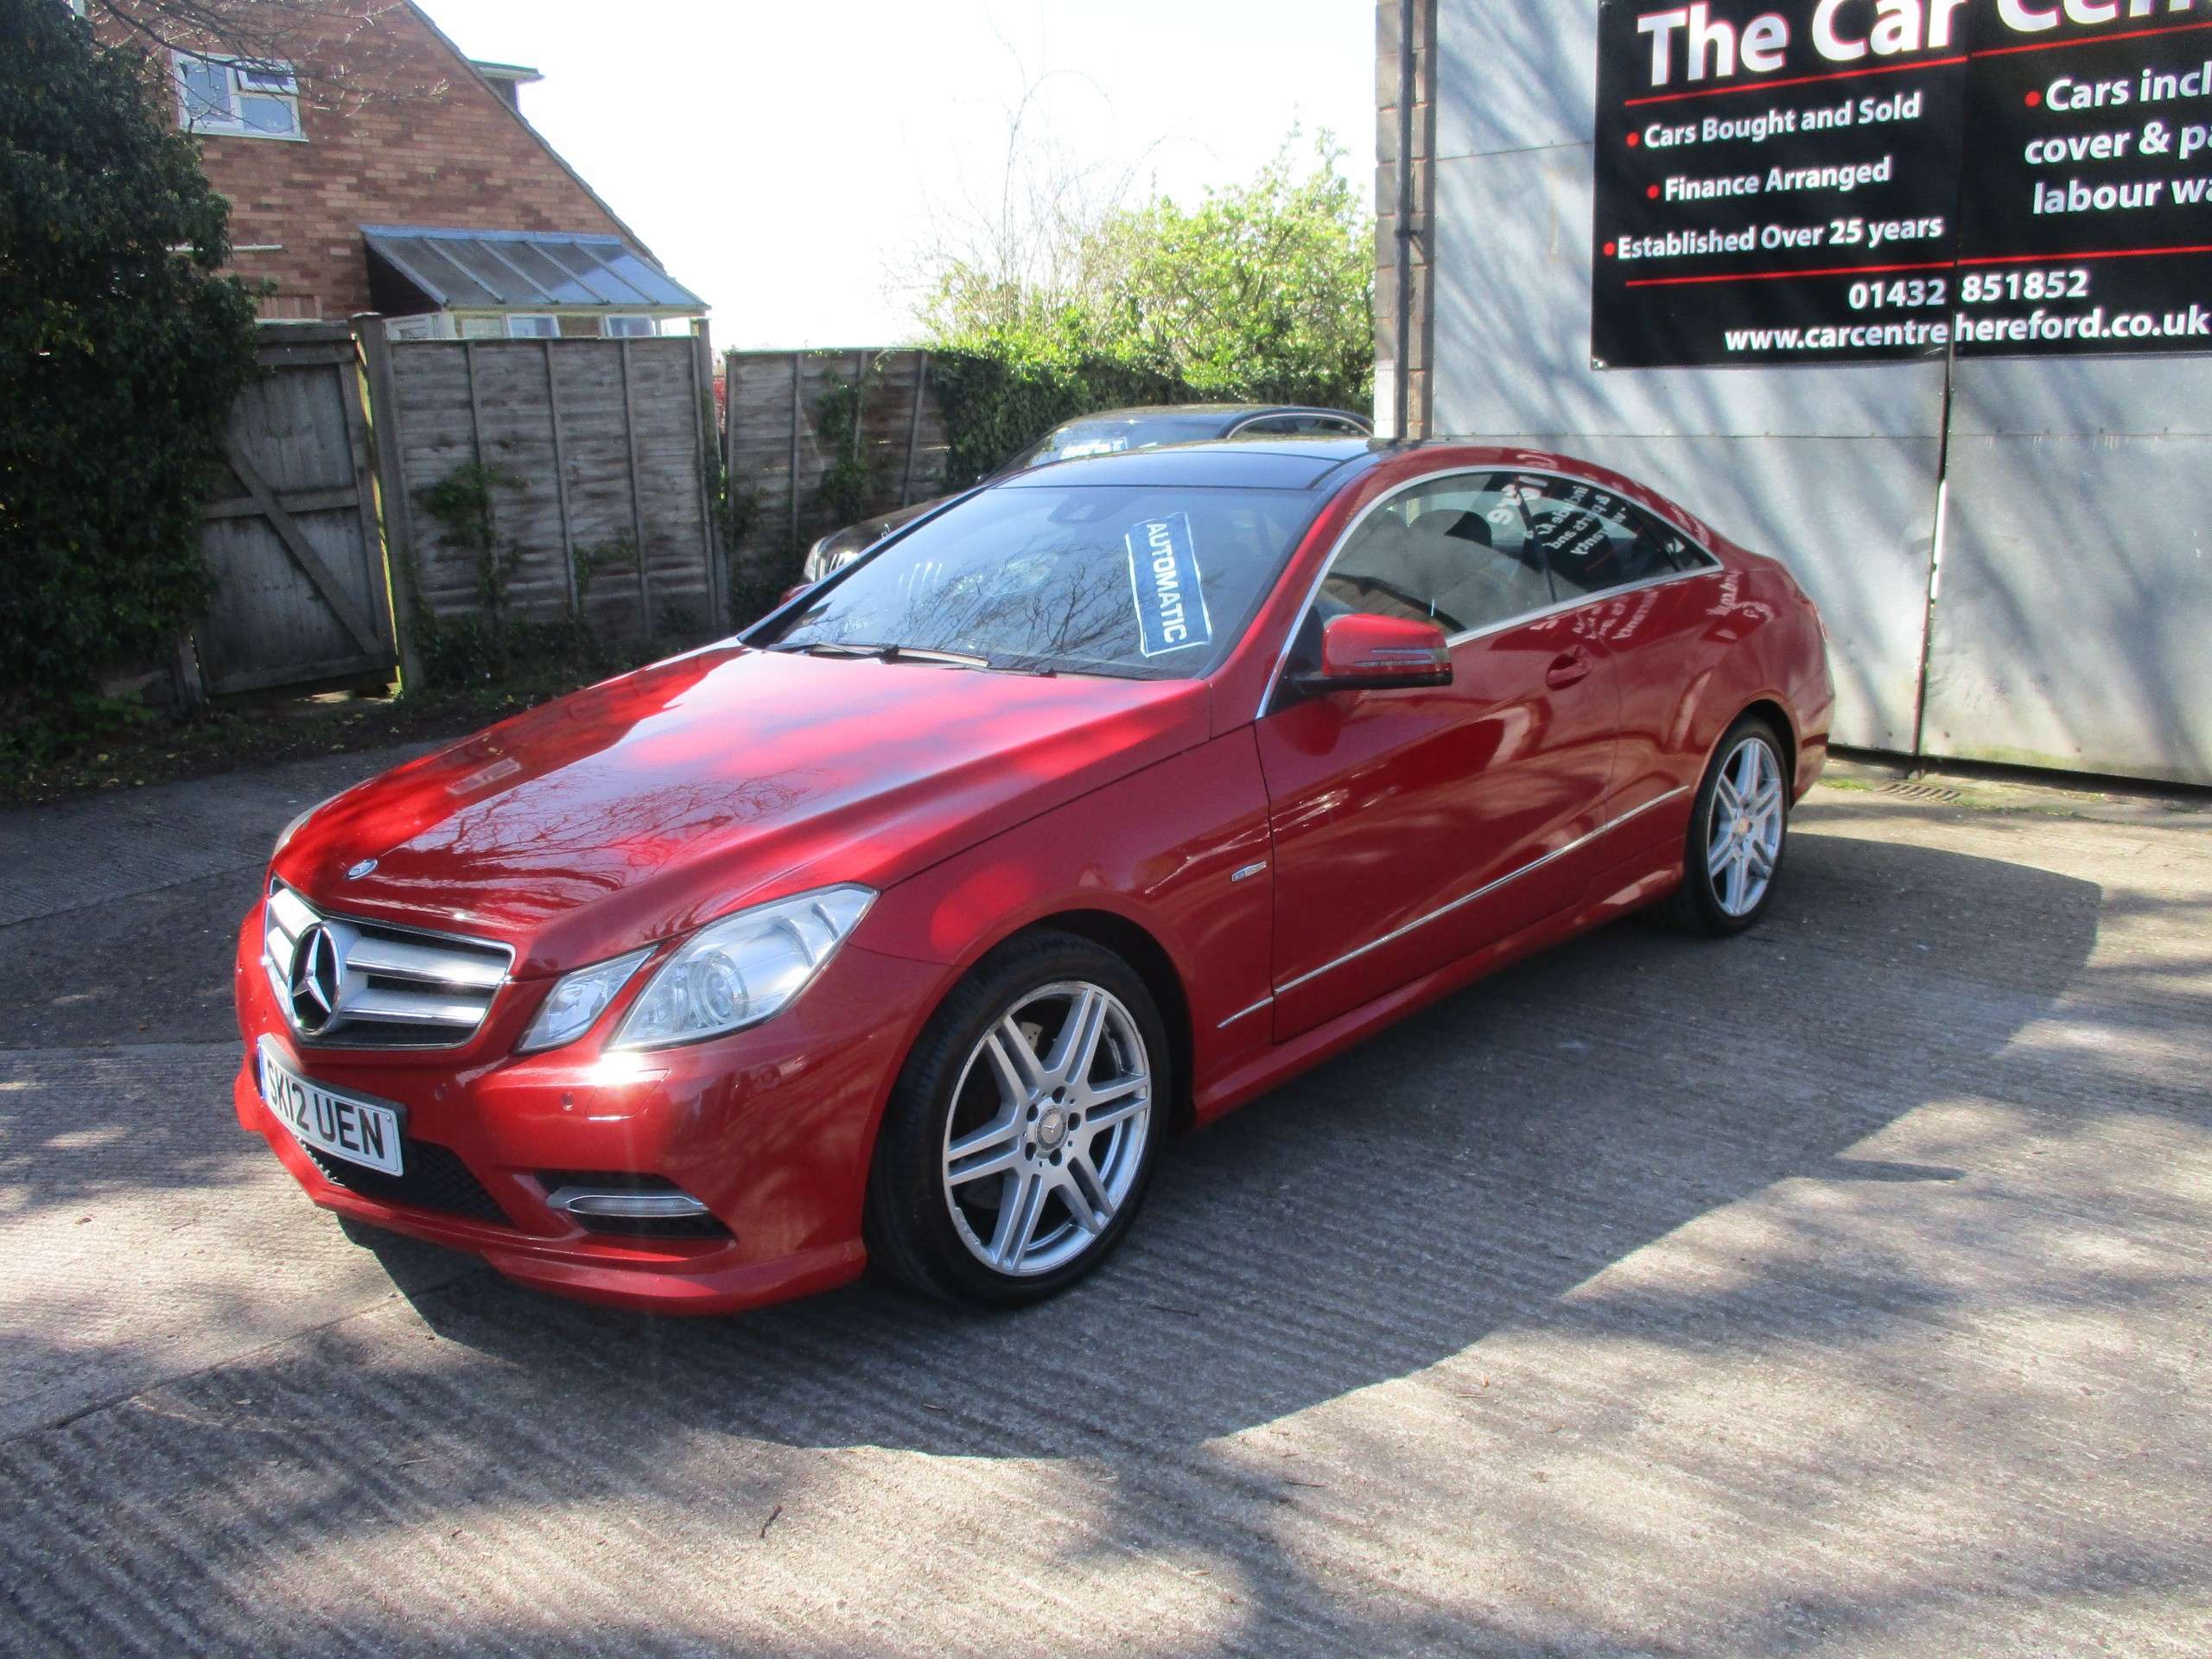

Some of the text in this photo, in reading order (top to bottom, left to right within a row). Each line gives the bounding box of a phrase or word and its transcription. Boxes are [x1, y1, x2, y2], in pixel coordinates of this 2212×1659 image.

[1638, 2, 1787, 86] The
[1812, 0, 1967, 61] Car
[2046, 61, 2212, 111] Cars incl
[1644, 92, 1923, 149] Cars Bought and Sold
[2024, 132, 2129, 164] cover
[2139, 122, 2170, 154] &
[1665, 156, 1892, 201] Finance Arranged
[2033, 179, 2163, 214] labour
[1618, 217, 1945, 259] Established Over 25 years
[1848, 268, 2089, 309] 01432 851852
[1147, 523, 1187, 643] AUTOMATIC
[267, 1059, 385, 1160] SK12 UEN
